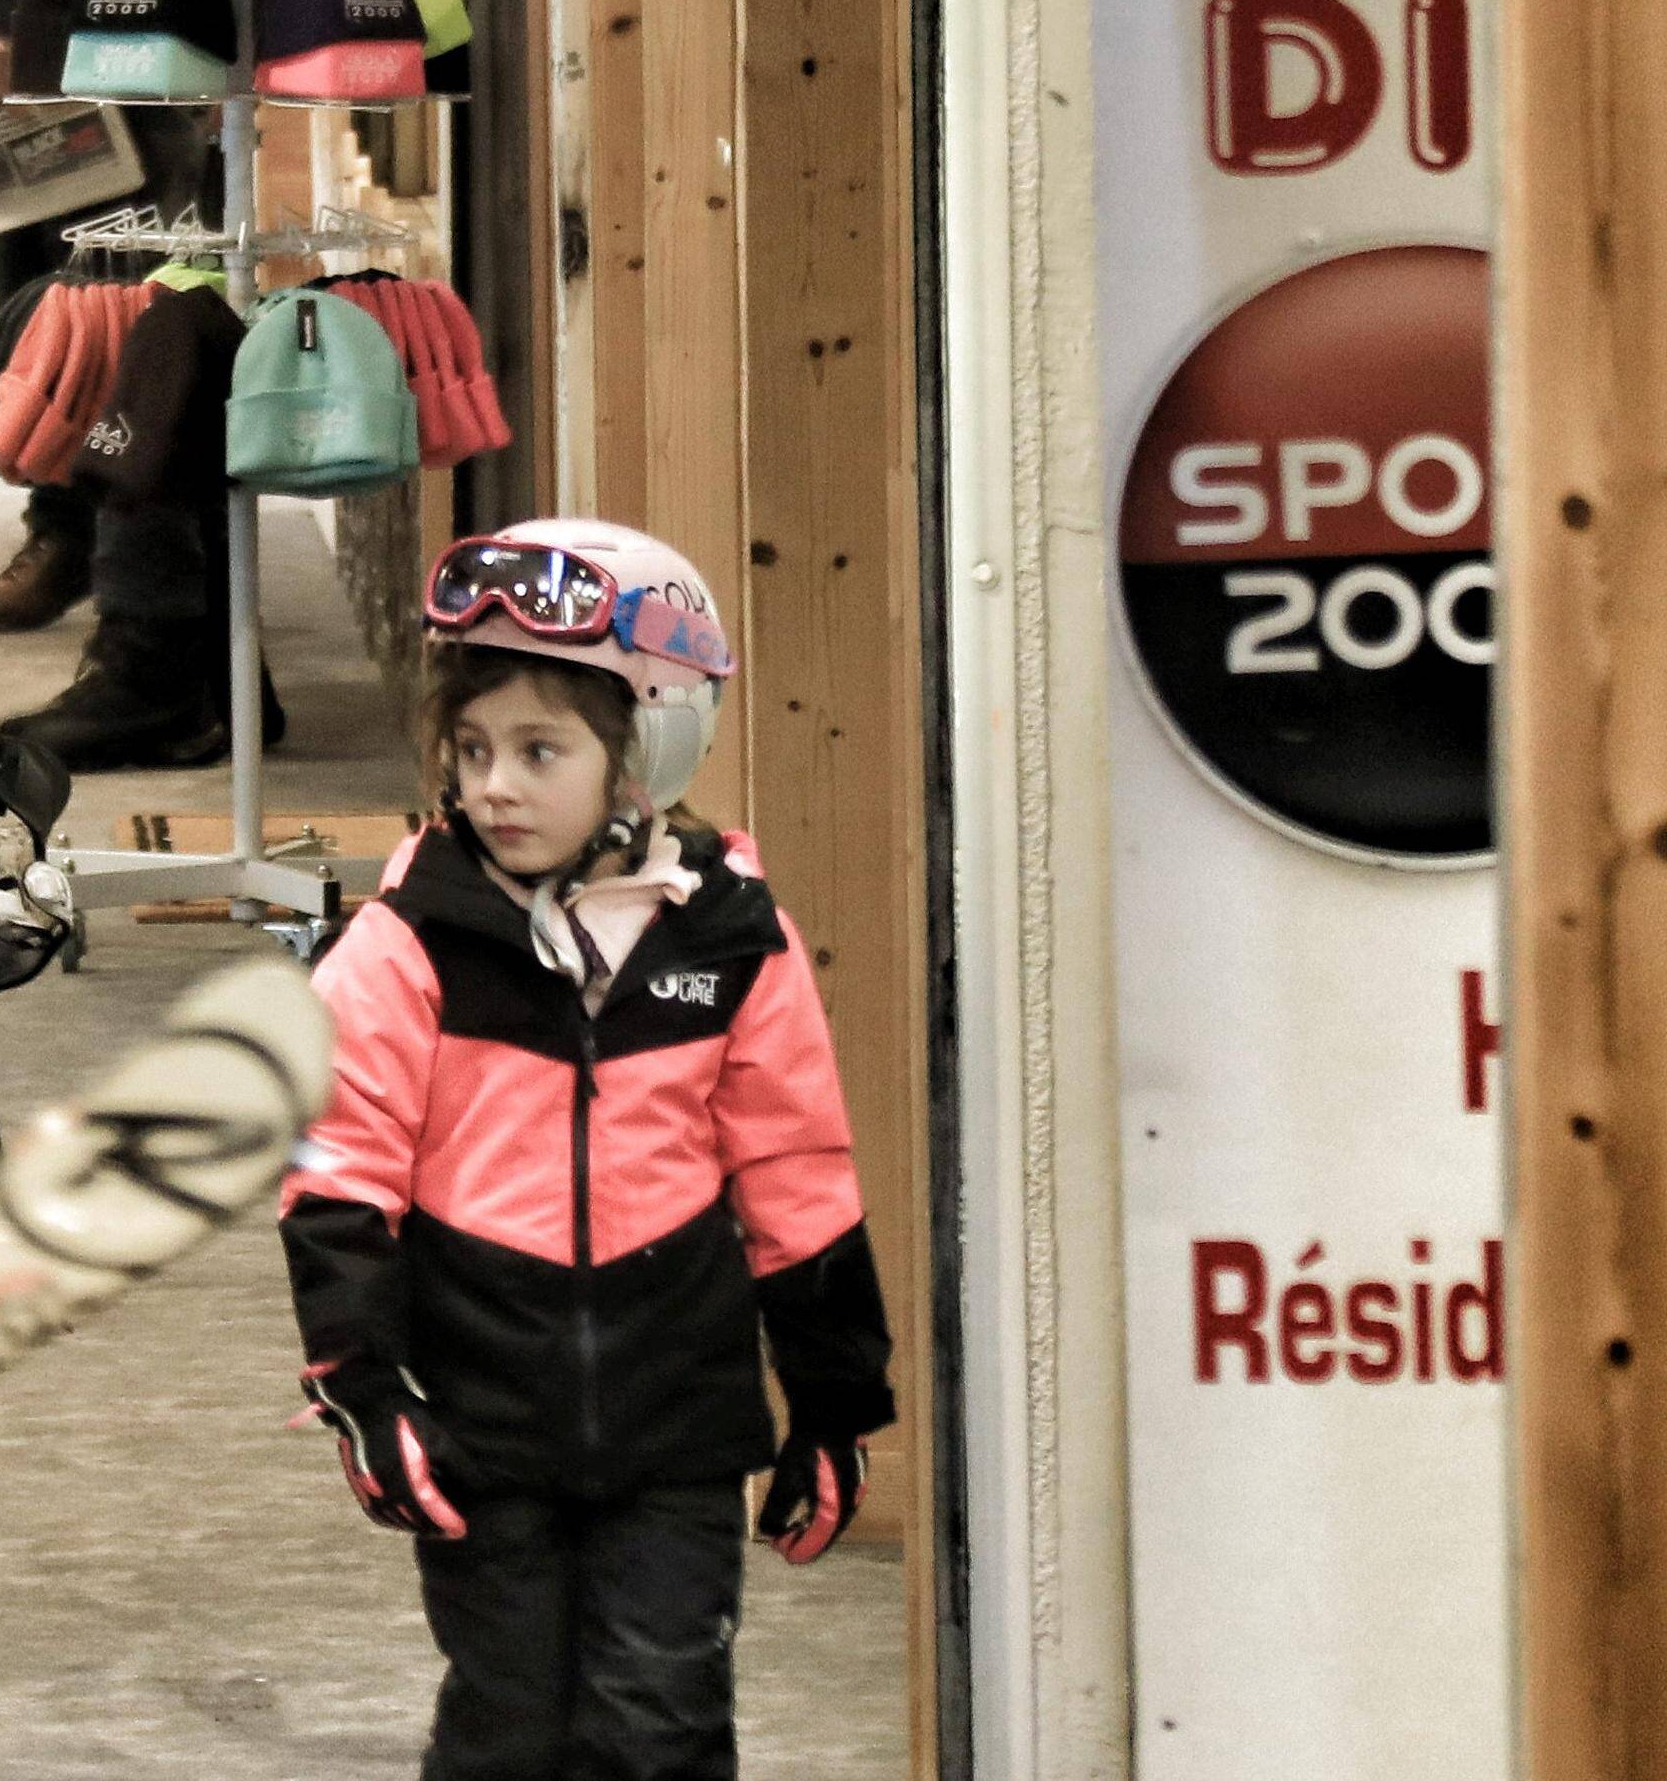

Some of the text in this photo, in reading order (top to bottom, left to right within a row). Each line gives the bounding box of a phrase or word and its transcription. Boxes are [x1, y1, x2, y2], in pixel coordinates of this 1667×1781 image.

[1168, 432, 1483, 548] SPO
[1224, 559, 1497, 675] 200
[1190, 1236, 1506, 1387] Résid
